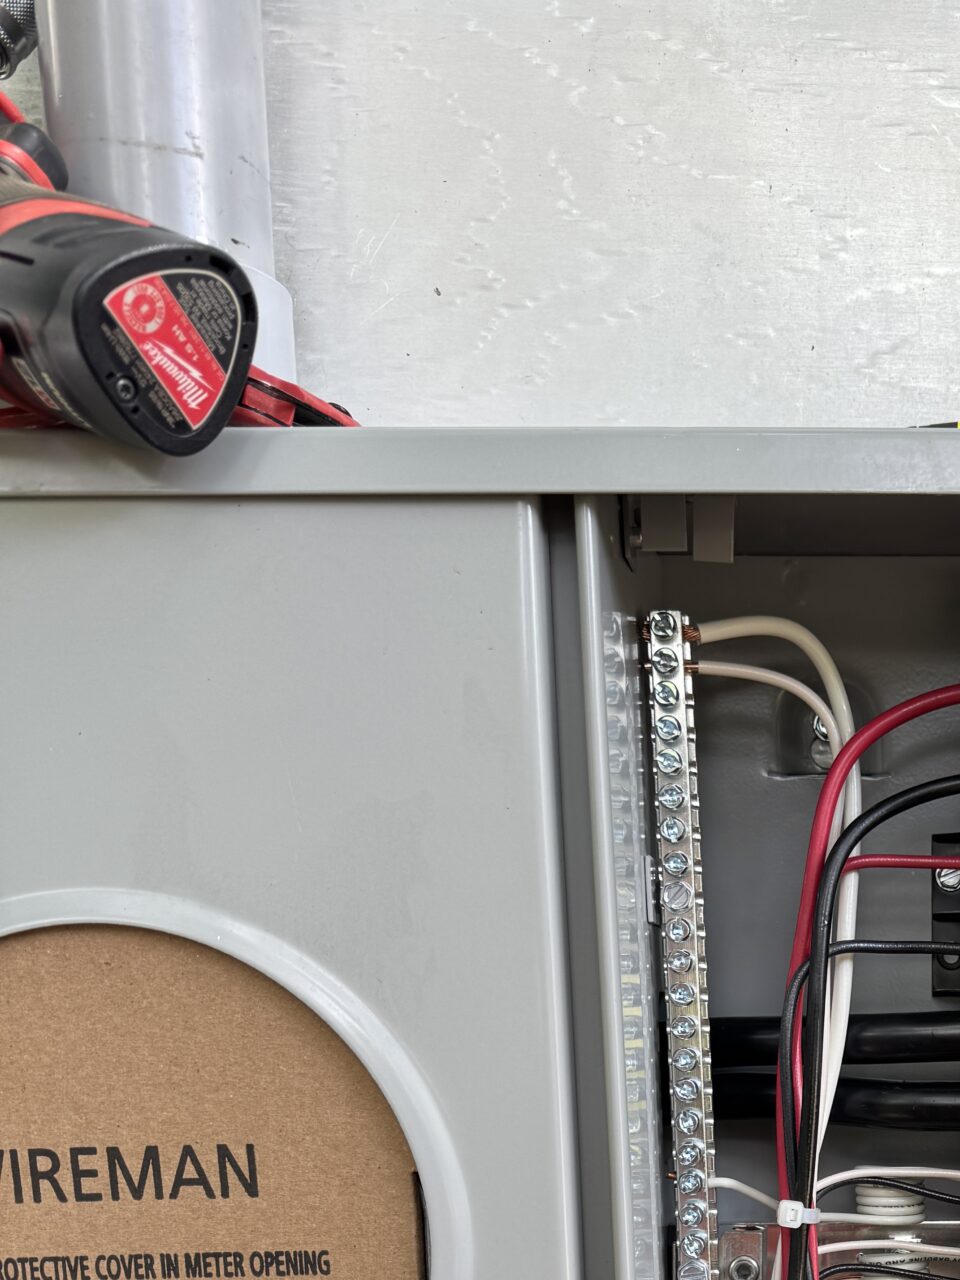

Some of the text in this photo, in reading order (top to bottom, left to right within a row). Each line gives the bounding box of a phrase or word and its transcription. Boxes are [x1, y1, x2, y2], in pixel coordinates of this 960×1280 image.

[142, 341, 208, 410] Milwaukee
[0, 1143, 259, 1204] IREMAN
[95, 1254, 156, 1280] COVER
[160, 1253, 180, 1280] IN
[184, 1252, 245, 1278] METER
[250, 1250, 331, 1277] OPENING
